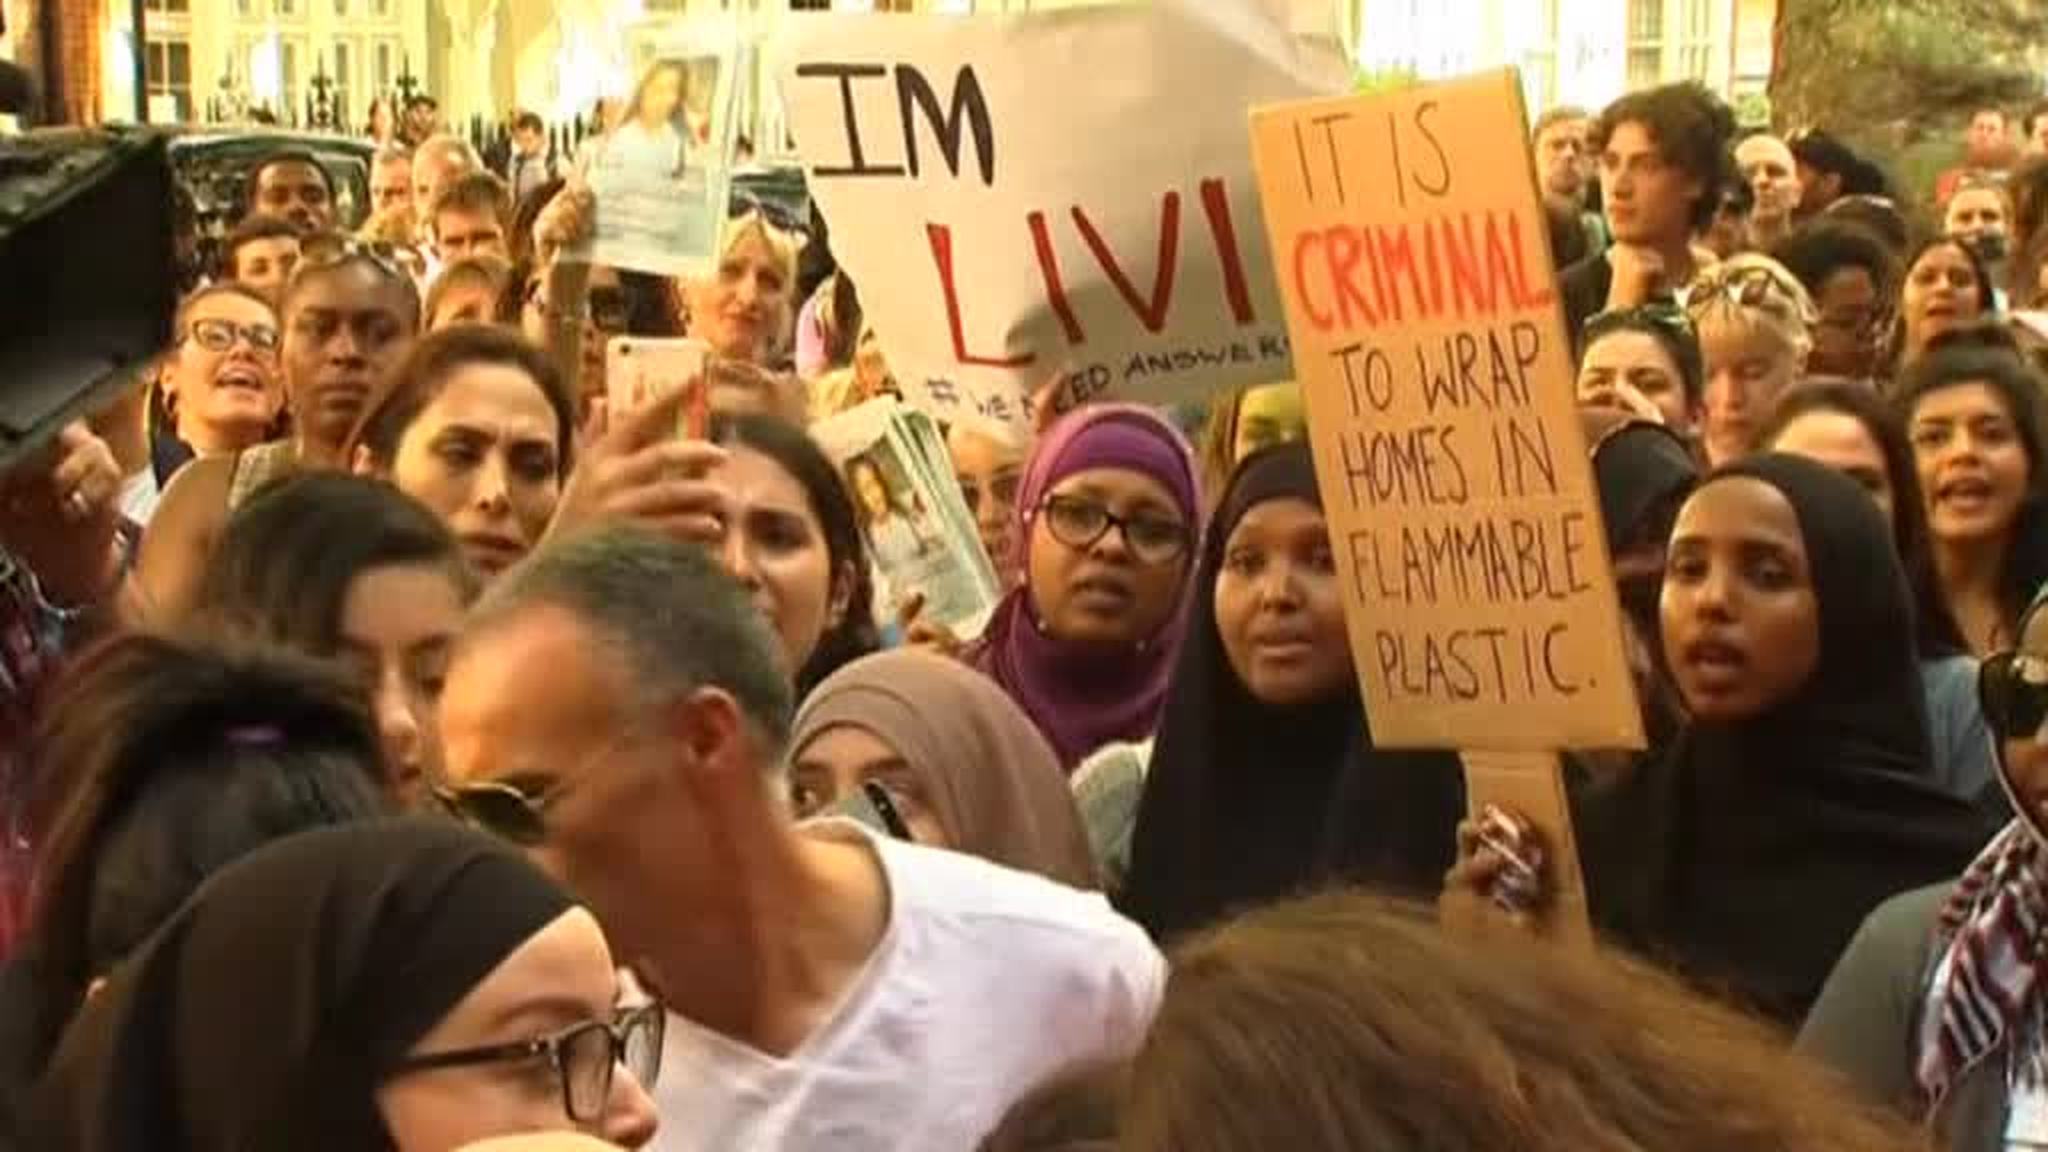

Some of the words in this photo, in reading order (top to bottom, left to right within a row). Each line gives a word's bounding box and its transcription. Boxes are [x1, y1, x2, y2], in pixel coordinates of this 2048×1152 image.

[1293, 112, 1352, 206] IT
[1388, 100, 1451, 208] IS
[1293, 208, 1556, 332] CRIMINAL
[1124, 334, 1290, 381] ANSWER
[1330, 343, 1393, 417] TO
[1416, 320, 1541, 412] WRAP
[1338, 424, 1469, 509] HOMES
[1491, 415, 1559, 498] IN
[1347, 511, 1592, 608] FLAMMABLE
[1375, 621, 1598, 705] PLASTIC.
